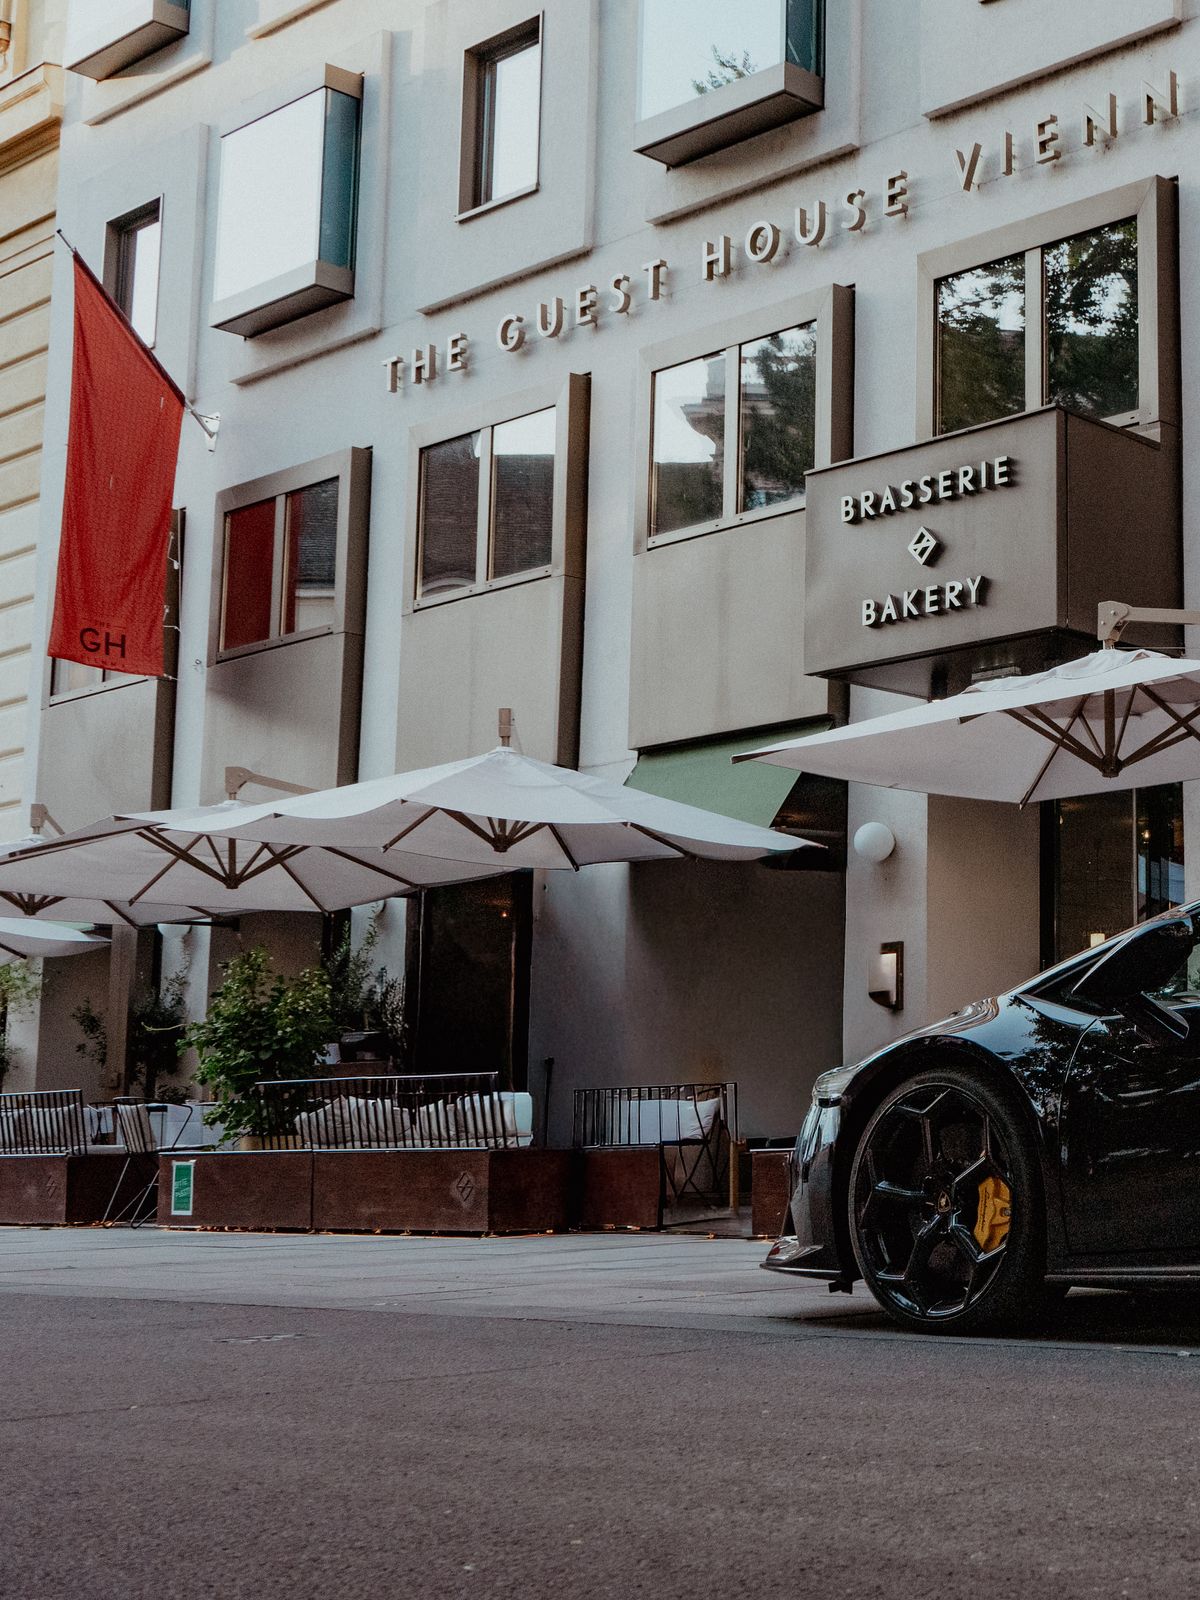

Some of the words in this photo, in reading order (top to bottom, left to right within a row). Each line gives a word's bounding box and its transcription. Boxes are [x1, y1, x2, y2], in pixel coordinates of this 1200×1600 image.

[381, 332, 468, 393] THE
[497, 258, 668, 353] GUEST
[701, 170, 909, 281] HOUSE
[840, 456, 1010, 523] BRASSERIE
[861, 575, 985, 626] BAKERY
[80, 627, 126, 658] GH
